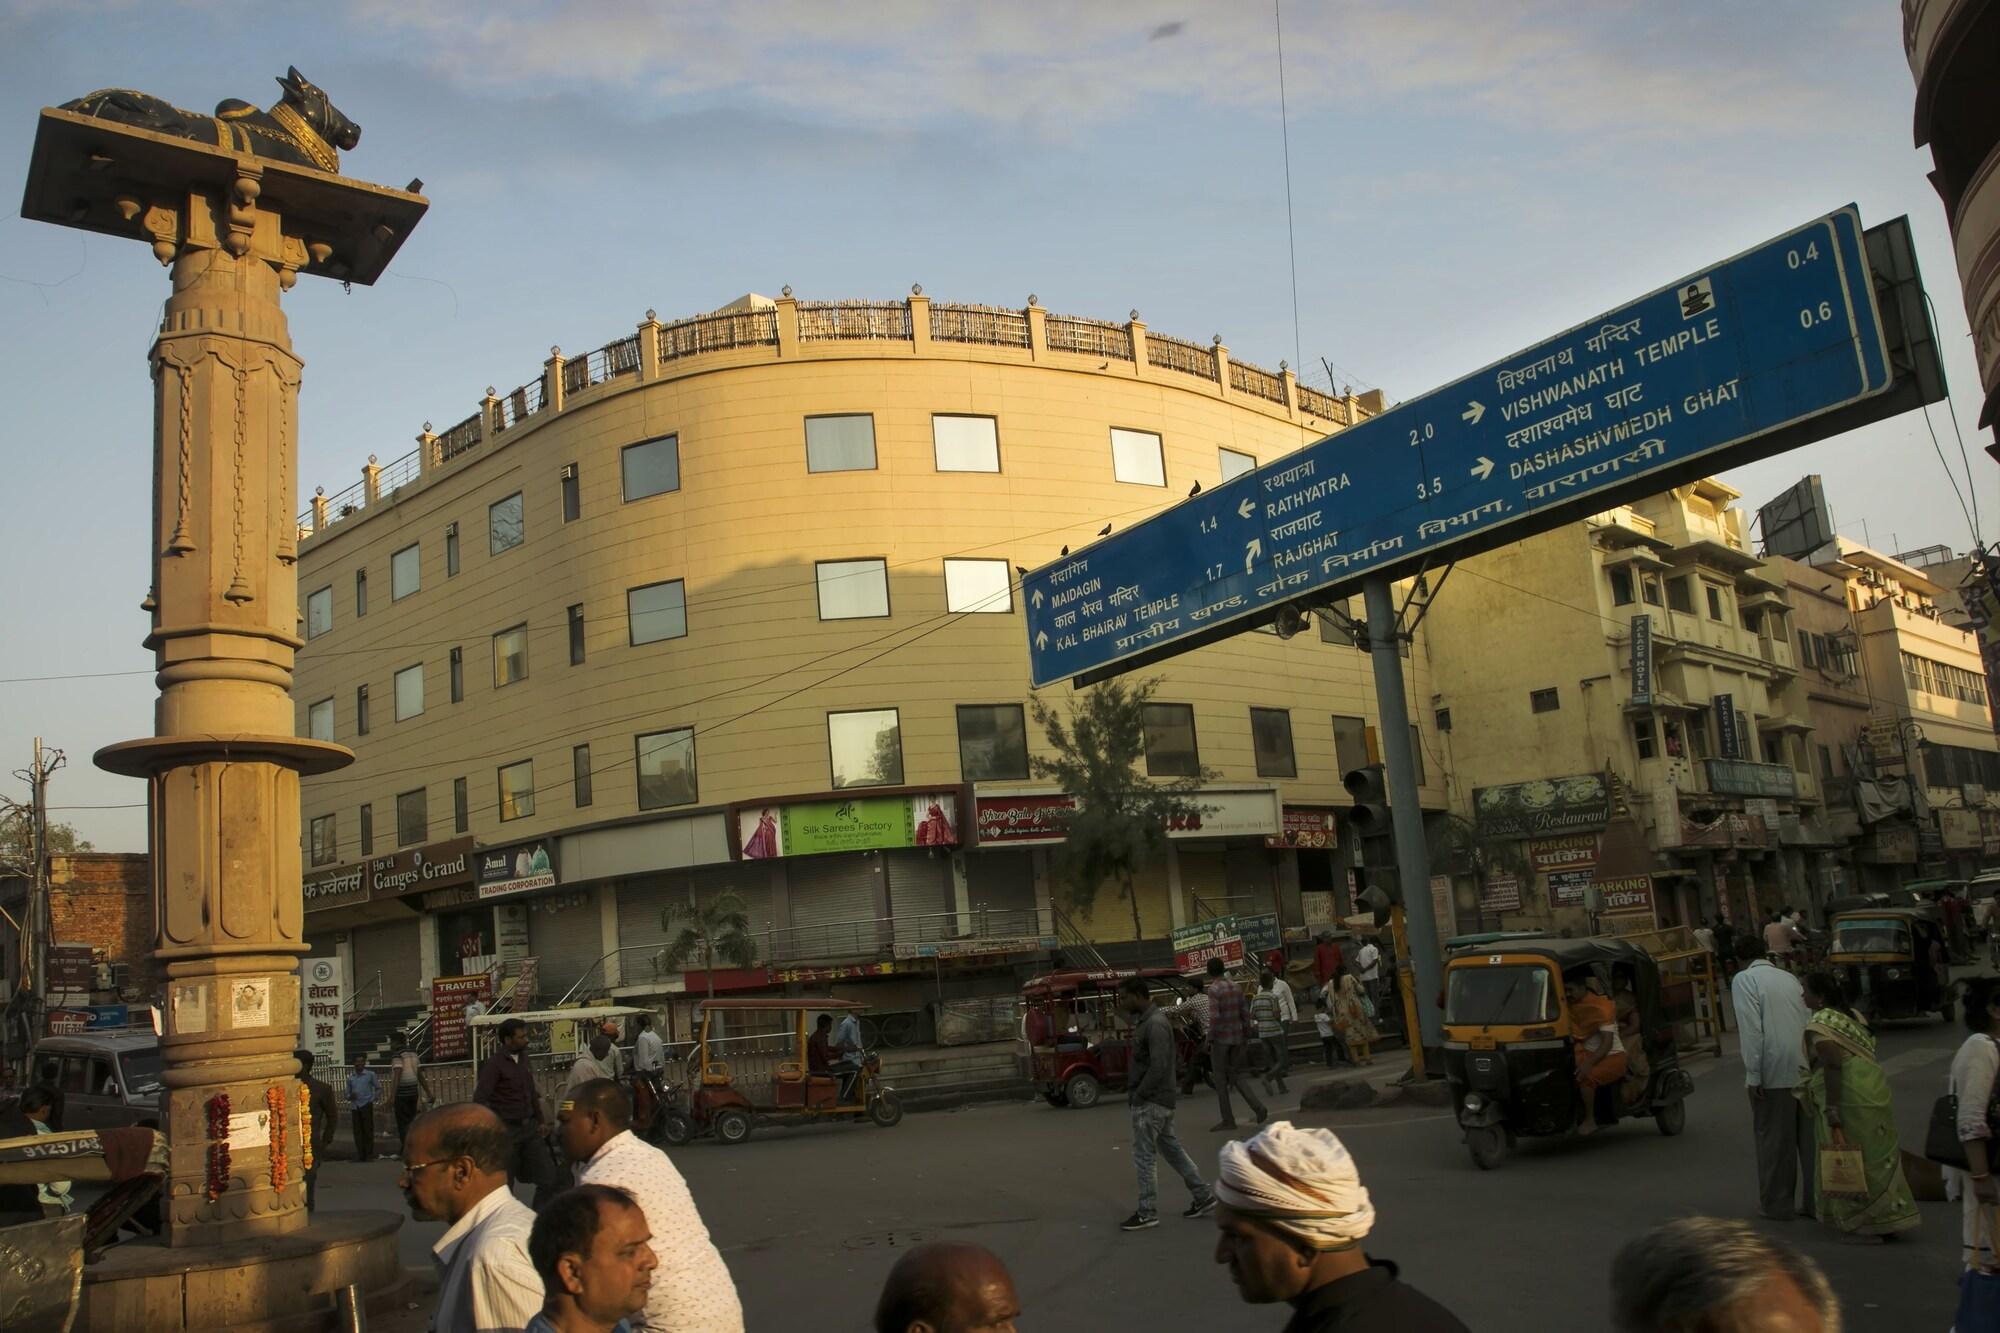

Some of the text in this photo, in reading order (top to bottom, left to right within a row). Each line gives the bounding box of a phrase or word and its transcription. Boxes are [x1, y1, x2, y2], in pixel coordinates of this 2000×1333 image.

[1787, 241, 1819, 269] 0.4
[1800, 301, 1832, 328] 0.6
[1497, 318, 1643, 394] विश्वनाथ मन्दिर
[1501, 318, 1721, 422] VISHWANATH TEMPLE
[1505, 382, 1644, 449] दशाश्वमेध घाट
[1509, 378, 1740, 480] DASHASHVMEDH GHAT
[1409, 423, 1434, 446] 2.0
[1264, 459, 1315, 492] रथयात्रा
[1416, 476, 1442, 500] 3.5
[1266, 473, 1351, 519] RATHYATRA
[1200, 515, 1217, 534] 1.4
[1256, 569, 1311, 597] लोक
[1321, 535, 1404, 574] निर्माण
[1522, 438, 1666, 500] वाराणसी
[1270, 510, 1322, 541] राजघाट
[1273, 531, 1339, 569] RAJGHAT
[1206, 563, 1223, 582] 1.7
[1051, 577, 1102, 609] MAIDAGIN
[1054, 610, 1076, 629] काल
[1108, 584, 1140, 607] मन्दिर
[1056, 634, 1078, 652] KAL
[1133, 593, 1180, 622] TEMPLE
[1636, 660, 1645, 692] HOTEL
[803, 820, 892, 835] Silk Sarees Factory
[1535, 808, 1608, 830] Restaurant
[1531, 836, 1594, 852] PARKING
[372, 856, 395, 872] Hoel
[373, 868, 419, 892] Ganges
[422, 854, 466, 880] Grand
[484, 854, 507, 870] Amul
[319, 867, 363, 897] ज्वेलर्स
[480, 876, 554, 896] TRADING CORPORATION
[1201, 945, 1228, 961] AIMIL
[308, 984, 338, 998] होटल
[438, 980, 485, 991] TRAVELS
